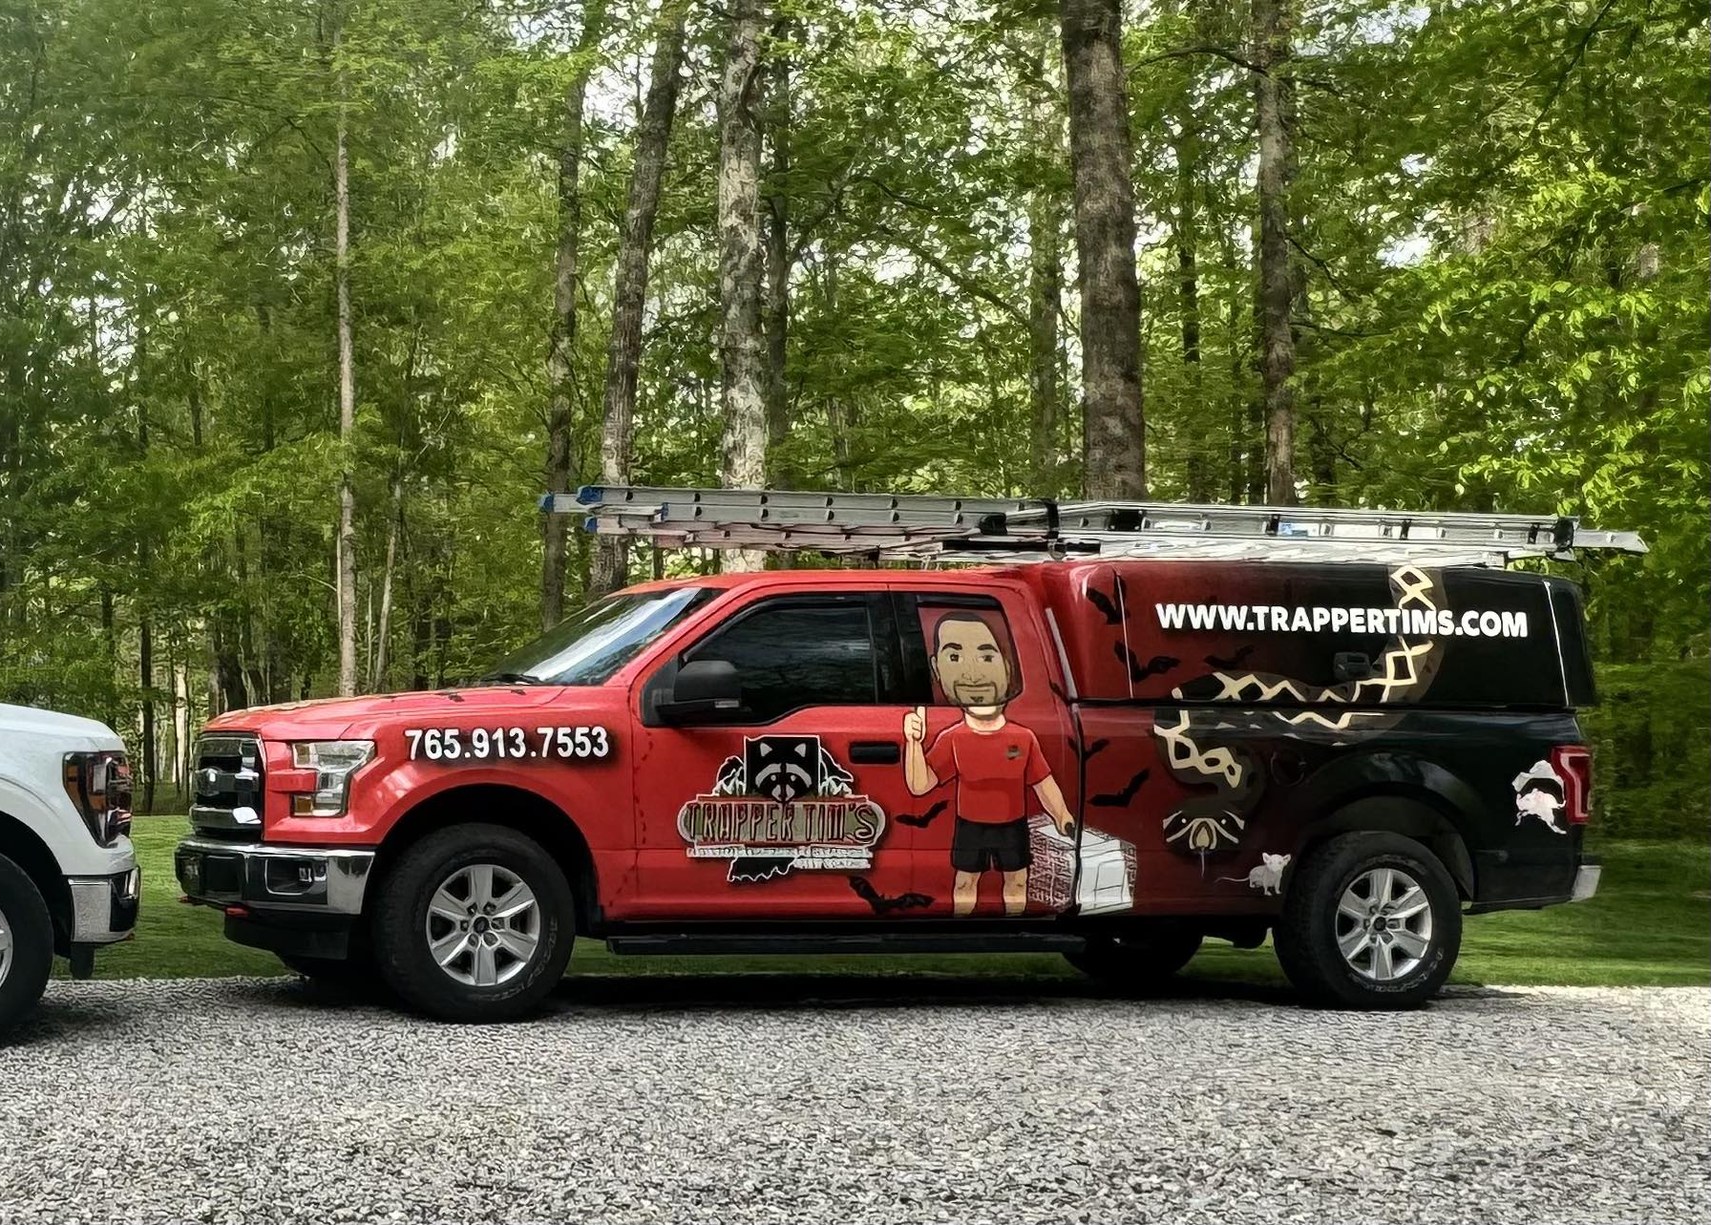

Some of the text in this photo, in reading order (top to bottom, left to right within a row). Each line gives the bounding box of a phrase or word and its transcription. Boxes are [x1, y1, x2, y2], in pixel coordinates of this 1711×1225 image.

[1155, 603, 1528, 637] WWW.TRAPPERTIMS.COM
[405, 727, 608, 760] 765.913.7553
[688, 802, 876, 843] TRAPPER TIM'S
